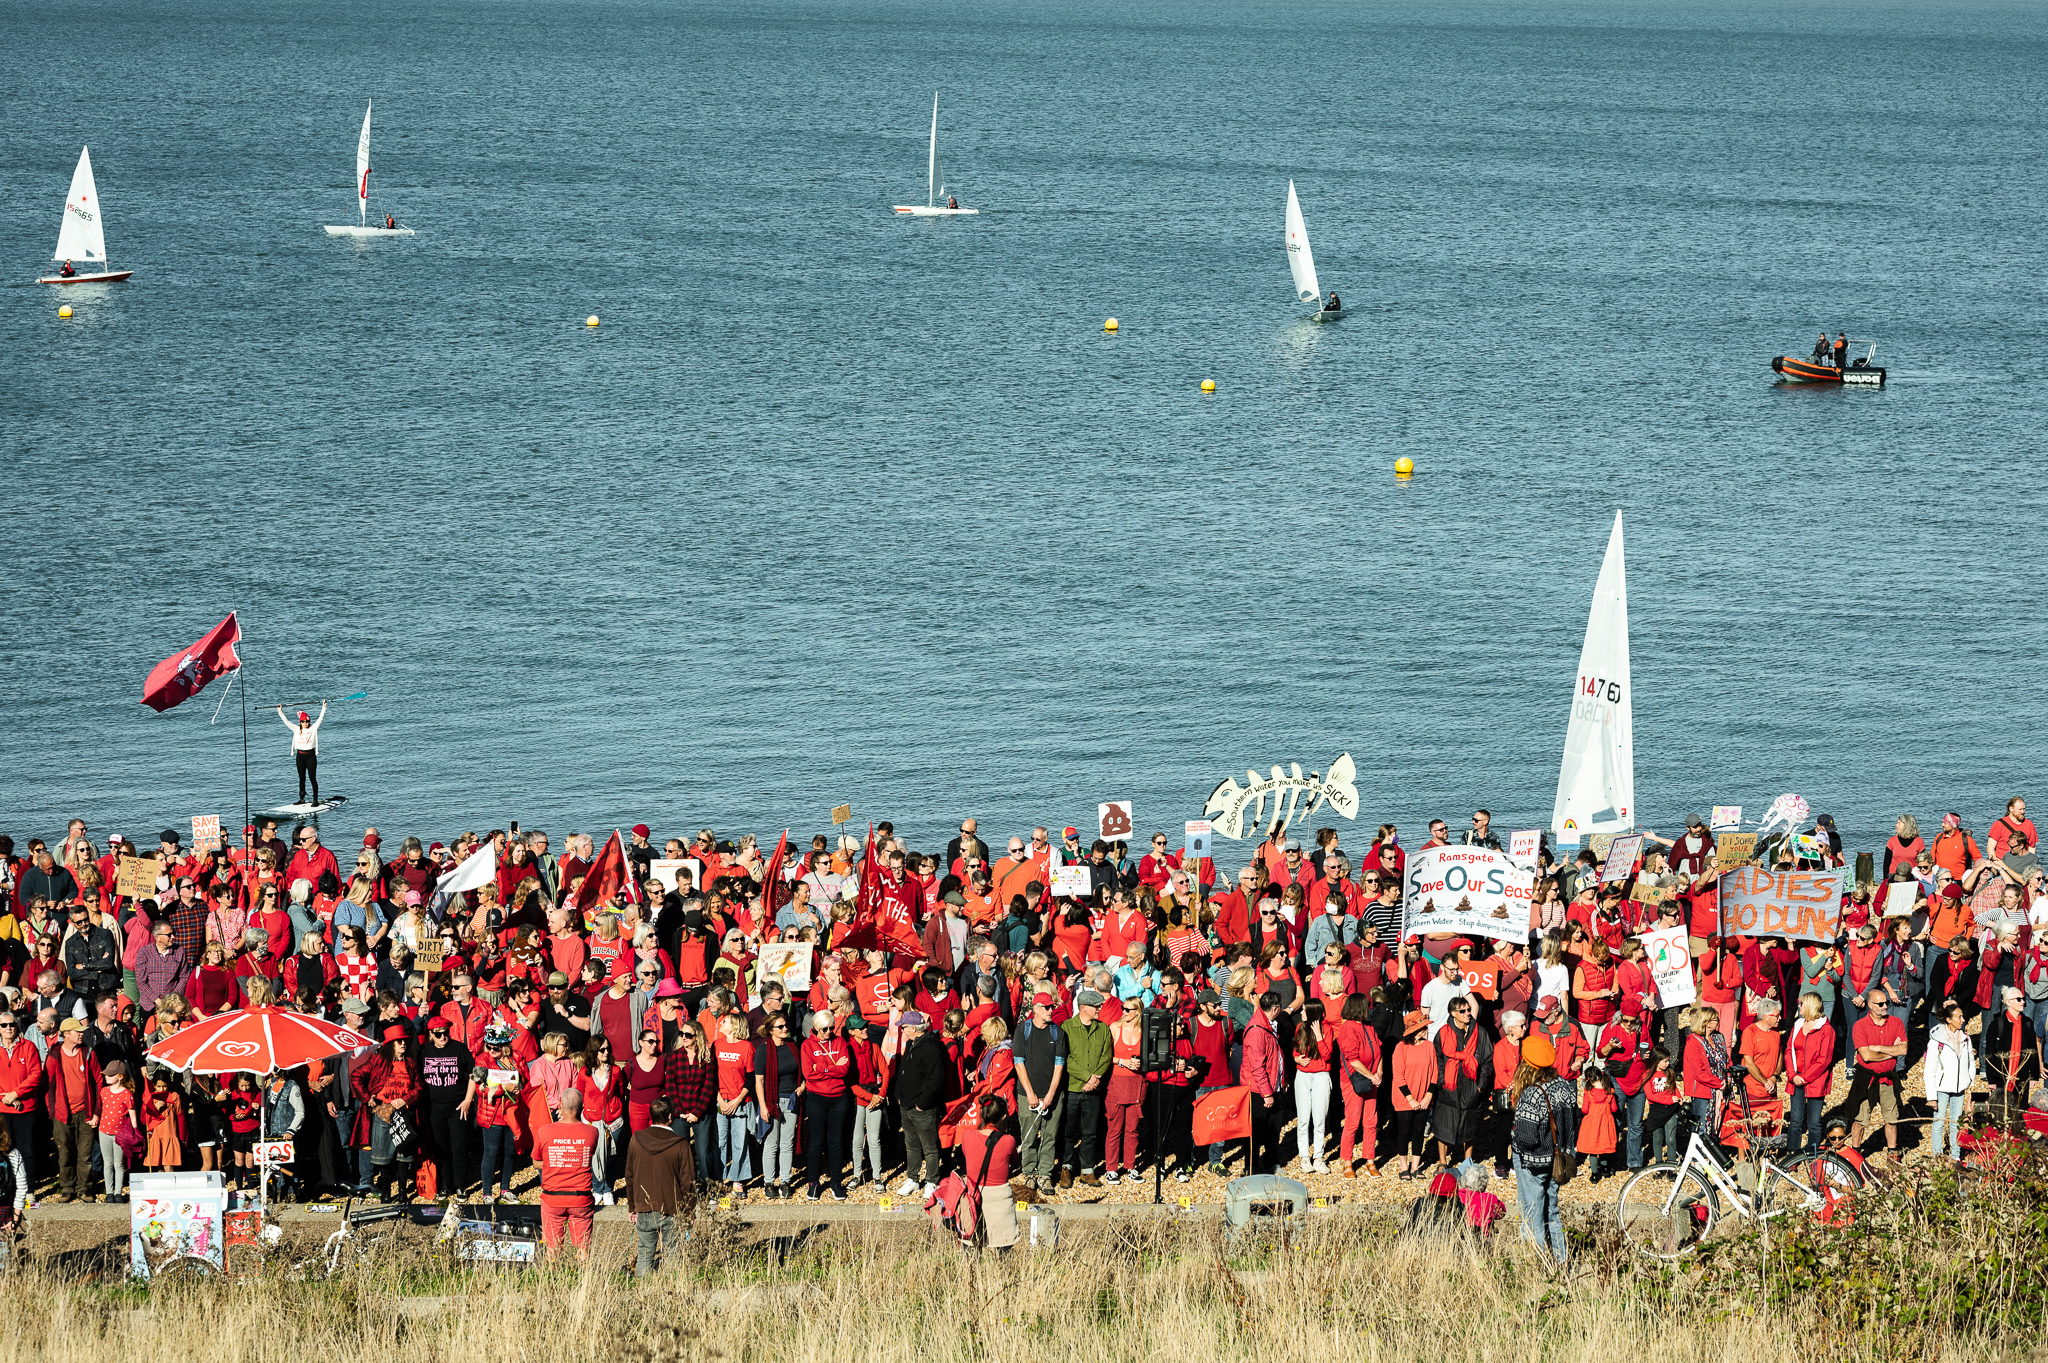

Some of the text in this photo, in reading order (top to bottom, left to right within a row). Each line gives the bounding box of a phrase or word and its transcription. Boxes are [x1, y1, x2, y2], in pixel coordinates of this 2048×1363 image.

[1227, 788, 1253, 825] Southern
[1278, 779, 1291, 787] you
[1292, 778, 1311, 788] make
[1313, 783, 1323, 791] us
[1324, 784, 1352, 810] SICK!
[193, 816, 218, 828] SAVE
[194, 827, 218, 838] OUR
[194, 838, 220, 850] SEAS
[1513, 838, 1534, 847] FISH
[1515, 847, 1534, 856] NOT
[1729, 845, 1748, 853] YOUR
[1439, 853, 1494, 864] Ramsgate
[1408, 866, 1533, 900] Save Our Seas
[1721, 867, 1836, 902] LADIES
[885, 896, 909, 925] THE
[1405, 917, 1524, 938] Southern Water Stop dumping sewage
[1722, 903, 1838, 940] HO DUNK
[418, 941, 444, 951] DIRTY
[592, 946, 619, 957] CHICAGO
[418, 953, 440, 963] TRUSS
[425, 1073, 442, 1086] with
[443, 1073, 459, 1086] shit
[252, 1143, 292, 1162] SOS
